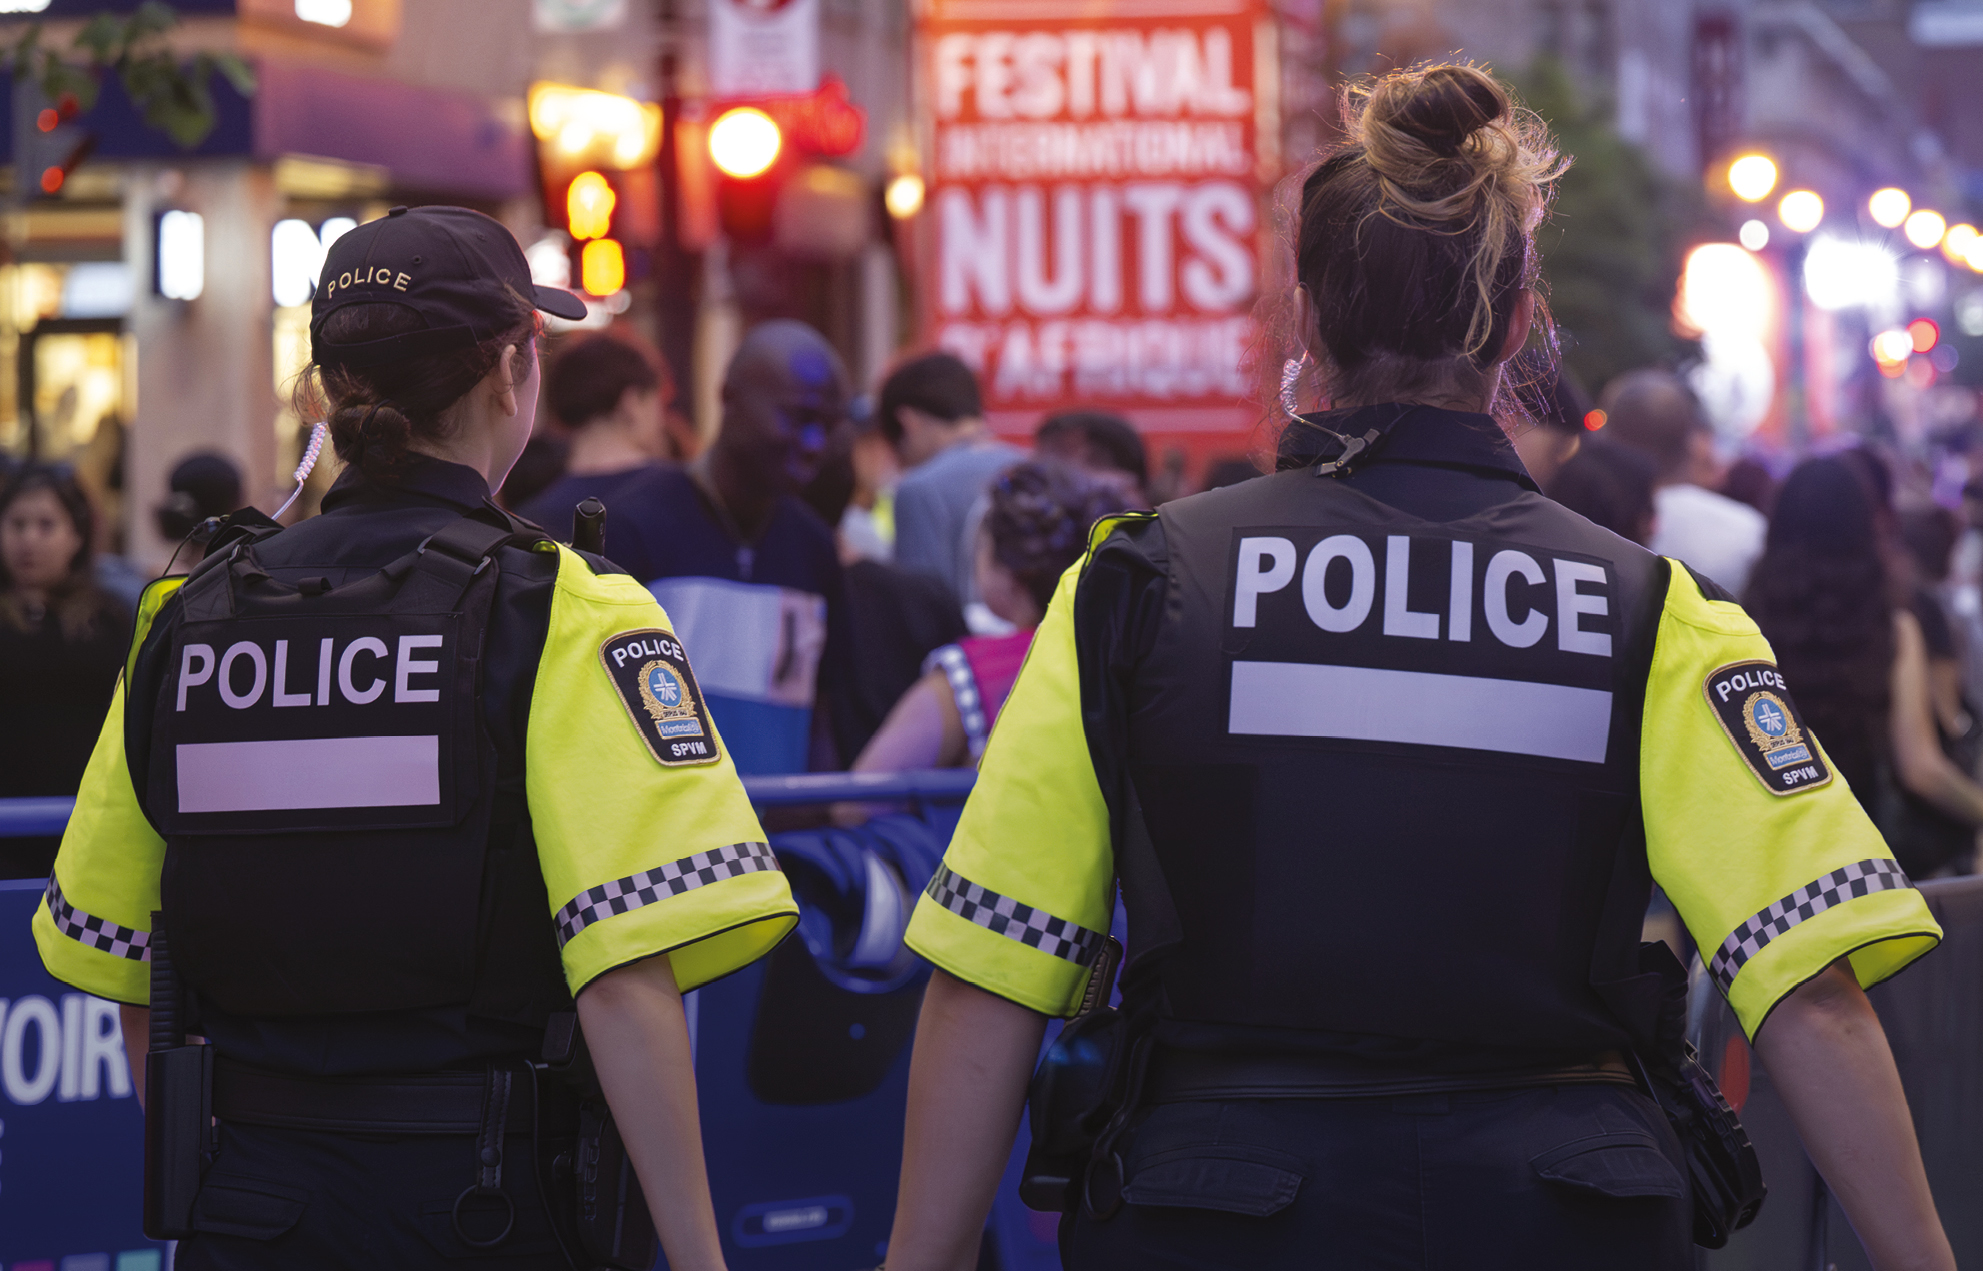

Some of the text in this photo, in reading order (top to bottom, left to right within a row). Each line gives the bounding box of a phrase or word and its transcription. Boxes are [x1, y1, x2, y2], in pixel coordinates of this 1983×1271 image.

[935, 28, 1252, 120] FESTIVAL
[942, 122, 1248, 177] INTERNATIONAL
[938, 182, 1256, 314] NUITS
[327, 266, 412, 300] POLICE
[1232, 534, 1613, 658] POLICE
[176, 634, 443, 712] POLICE
[611, 639, 684, 668] POLICE
[1715, 670, 1787, 702] POLICE
[671, 741, 708, 757] SPVM
[1782, 765, 1819, 785] SPVM
[0, 993, 133, 1106] OIR
